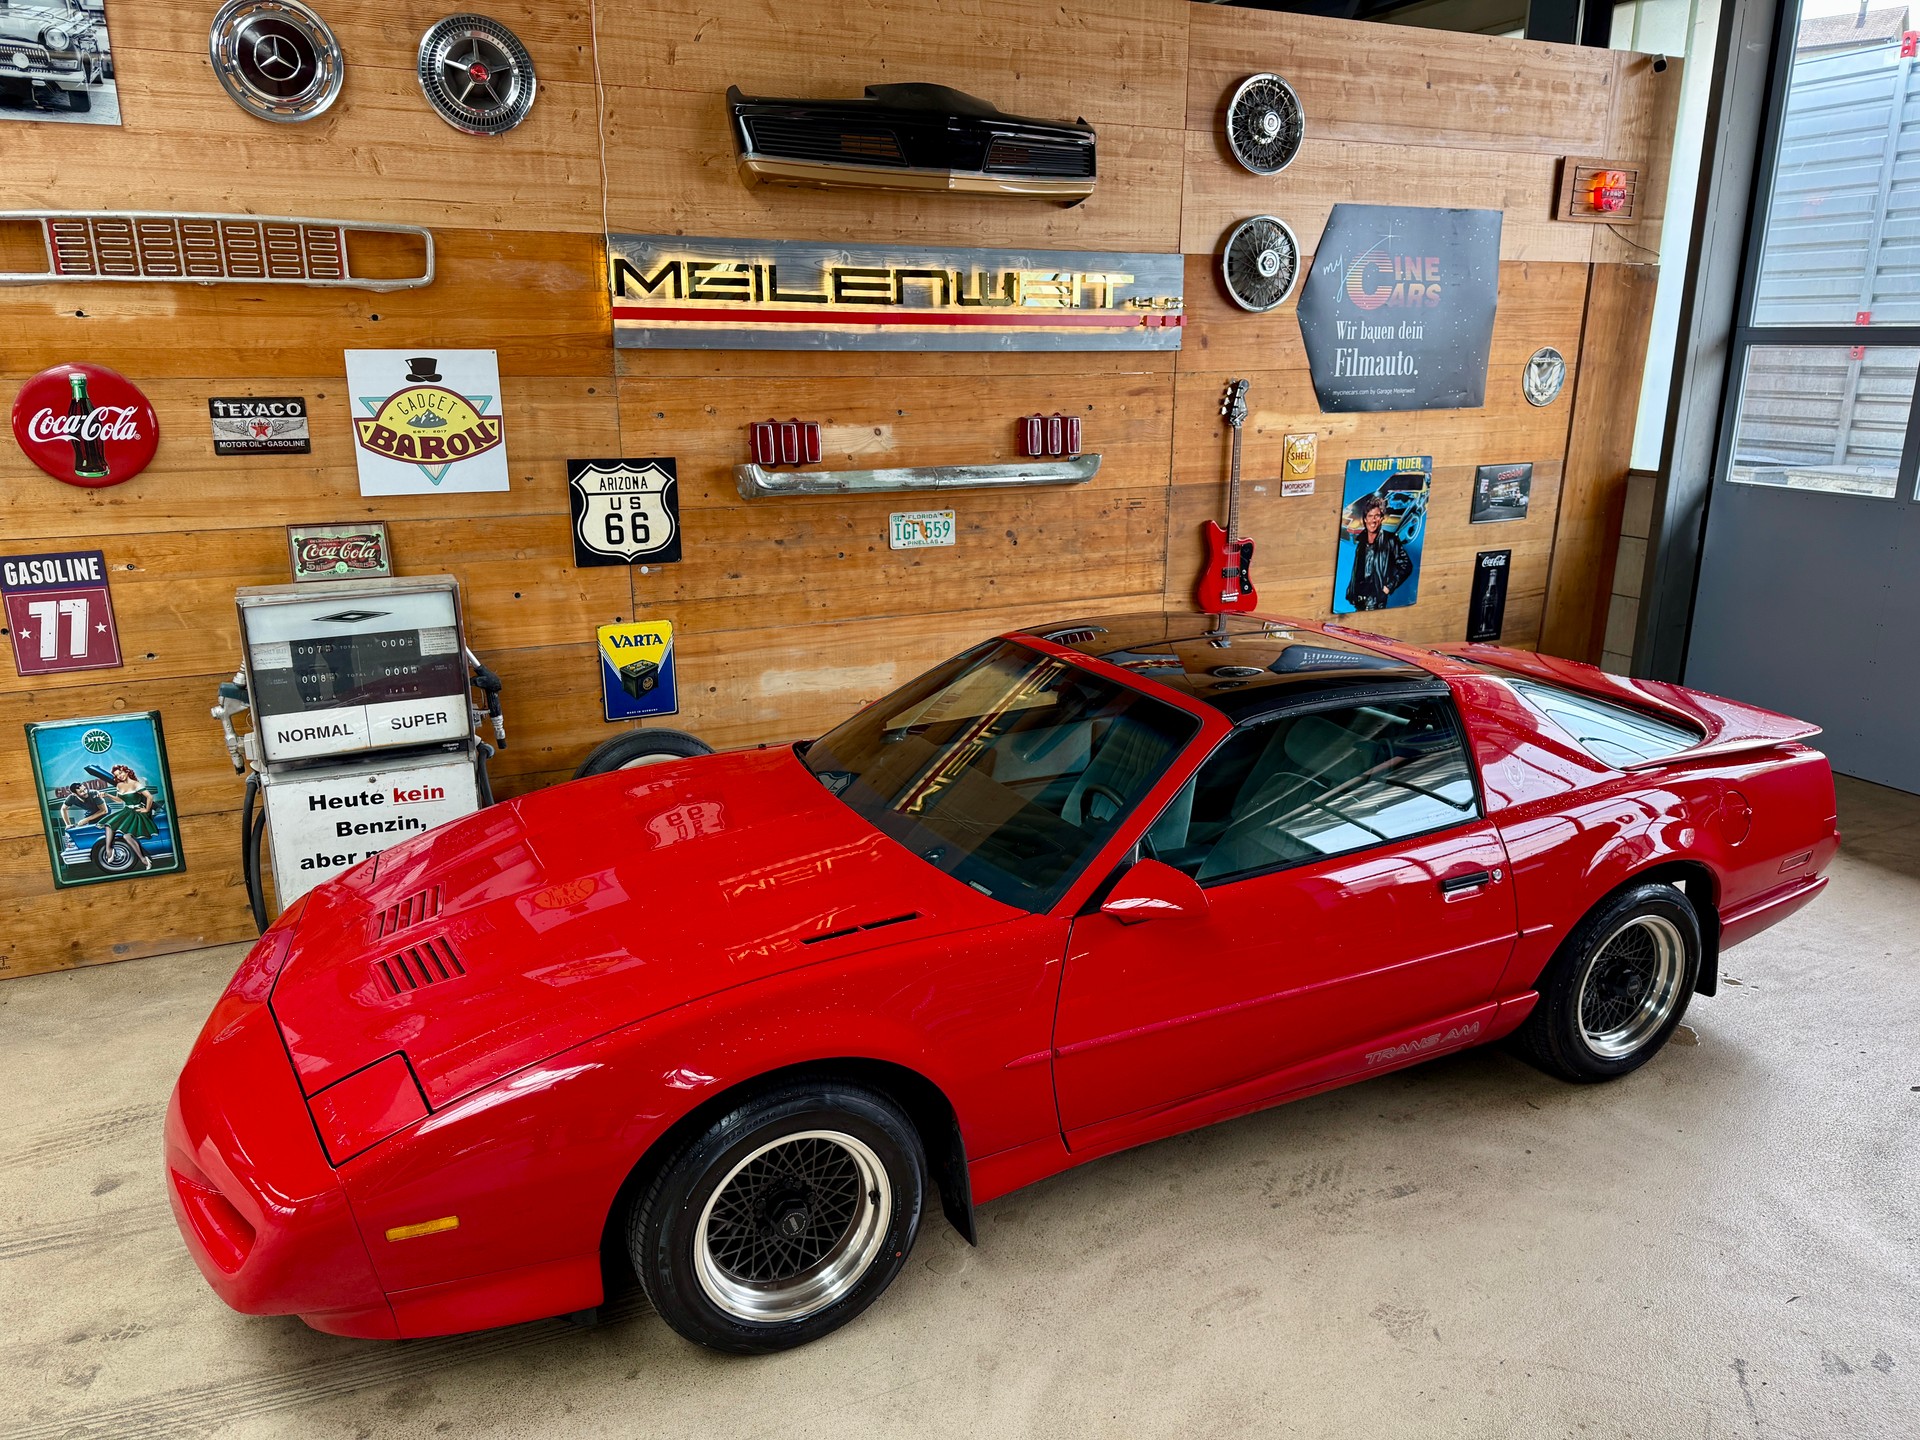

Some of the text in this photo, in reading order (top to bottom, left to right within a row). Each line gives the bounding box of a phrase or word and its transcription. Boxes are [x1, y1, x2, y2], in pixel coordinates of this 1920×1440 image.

[613, 258, 1134, 309] MEILENWEIT
[1336, 320, 1424, 340] Wir bauen dein
[1334, 348, 1418, 377] Filmauto.
[1370, 387, 1375, 395] by
[213, 402, 301, 417] TEXACO
[396, 393, 457, 415] GADGET
[28, 405, 138, 442] Coca-Cola
[366, 421, 497, 459] BARON
[1291, 451, 1311, 461] SHELL
[1360, 458, 1393, 472] KNIGHT
[1497, 467, 1523, 480] OSRAM
[599, 476, 648, 491] ARIZONA
[605, 512, 650, 545] 66
[925, 520, 951, 539] 559
[302, 541, 376, 560] Coca-Cola
[1481, 554, 1507, 568] Coca-Cola
[4, 557, 101, 586] GASOLINE
[609, 633, 663, 648] VARTA
[391, 712, 448, 730] SUPER
[277, 723, 354, 744] NORMAL
[309, 785, 445, 811] Heute kein
[336, 815, 427, 838] Benzin,
[300, 851, 357, 870] aber
[1365, 1021, 1480, 1065] TRANS AM
